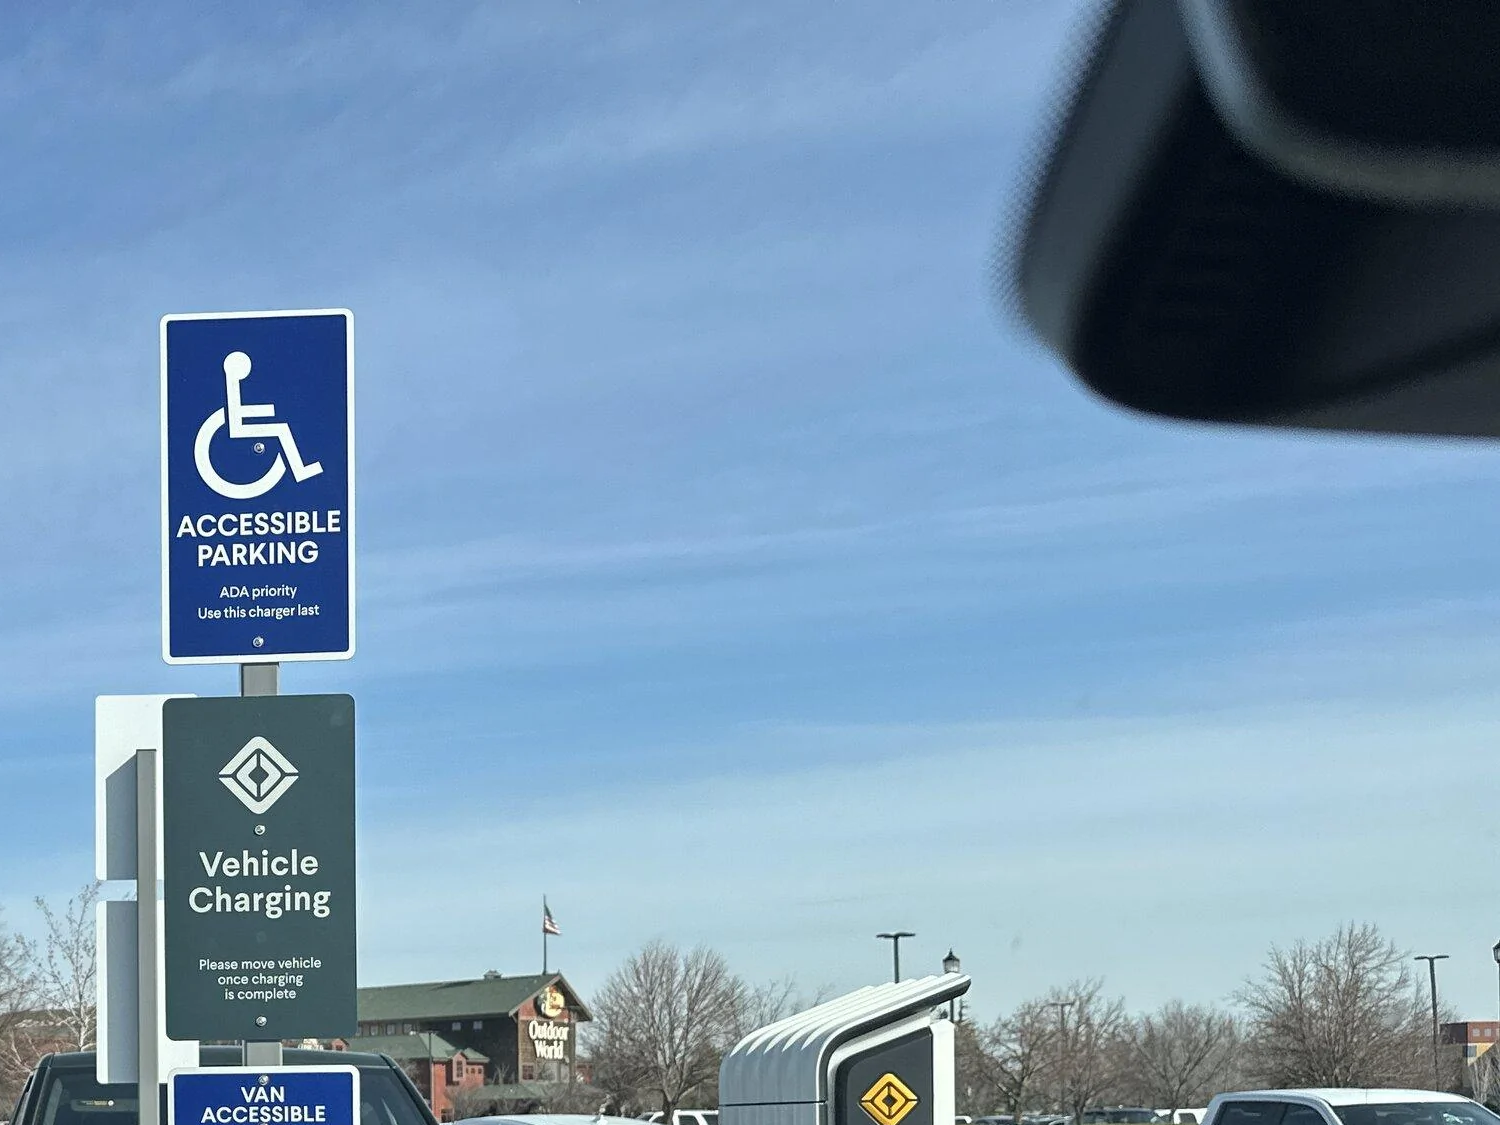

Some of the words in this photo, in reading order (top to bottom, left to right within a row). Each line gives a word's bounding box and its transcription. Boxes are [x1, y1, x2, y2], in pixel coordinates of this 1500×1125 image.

[176, 509, 342, 538] ACCESSIBLE
[197, 540, 319, 567] PARKING
[219, 585, 250, 599] ADA
[251, 584, 298, 600] priority
[197, 606, 222, 620] Use
[223, 605, 247, 618] this
[248, 604, 295, 620] charger
[297, 603, 320, 616] last
[199, 848, 319, 878] Vehicle
[188, 884, 331, 919] Charging
[199, 958, 239, 971] Please
[241, 959, 275, 970] move
[277, 956, 322, 969] vehicle
[217, 974, 249, 985] once
[251, 972, 304, 987] charging
[224, 988, 235, 1000] is
[237, 987, 297, 1002] complete
[528, 1020, 569, 1041] Outdoor
[533, 1040, 564, 1060] World
[240, 1086, 285, 1103] VAN
[201, 1105, 326, 1124] ACCESSIBLE
